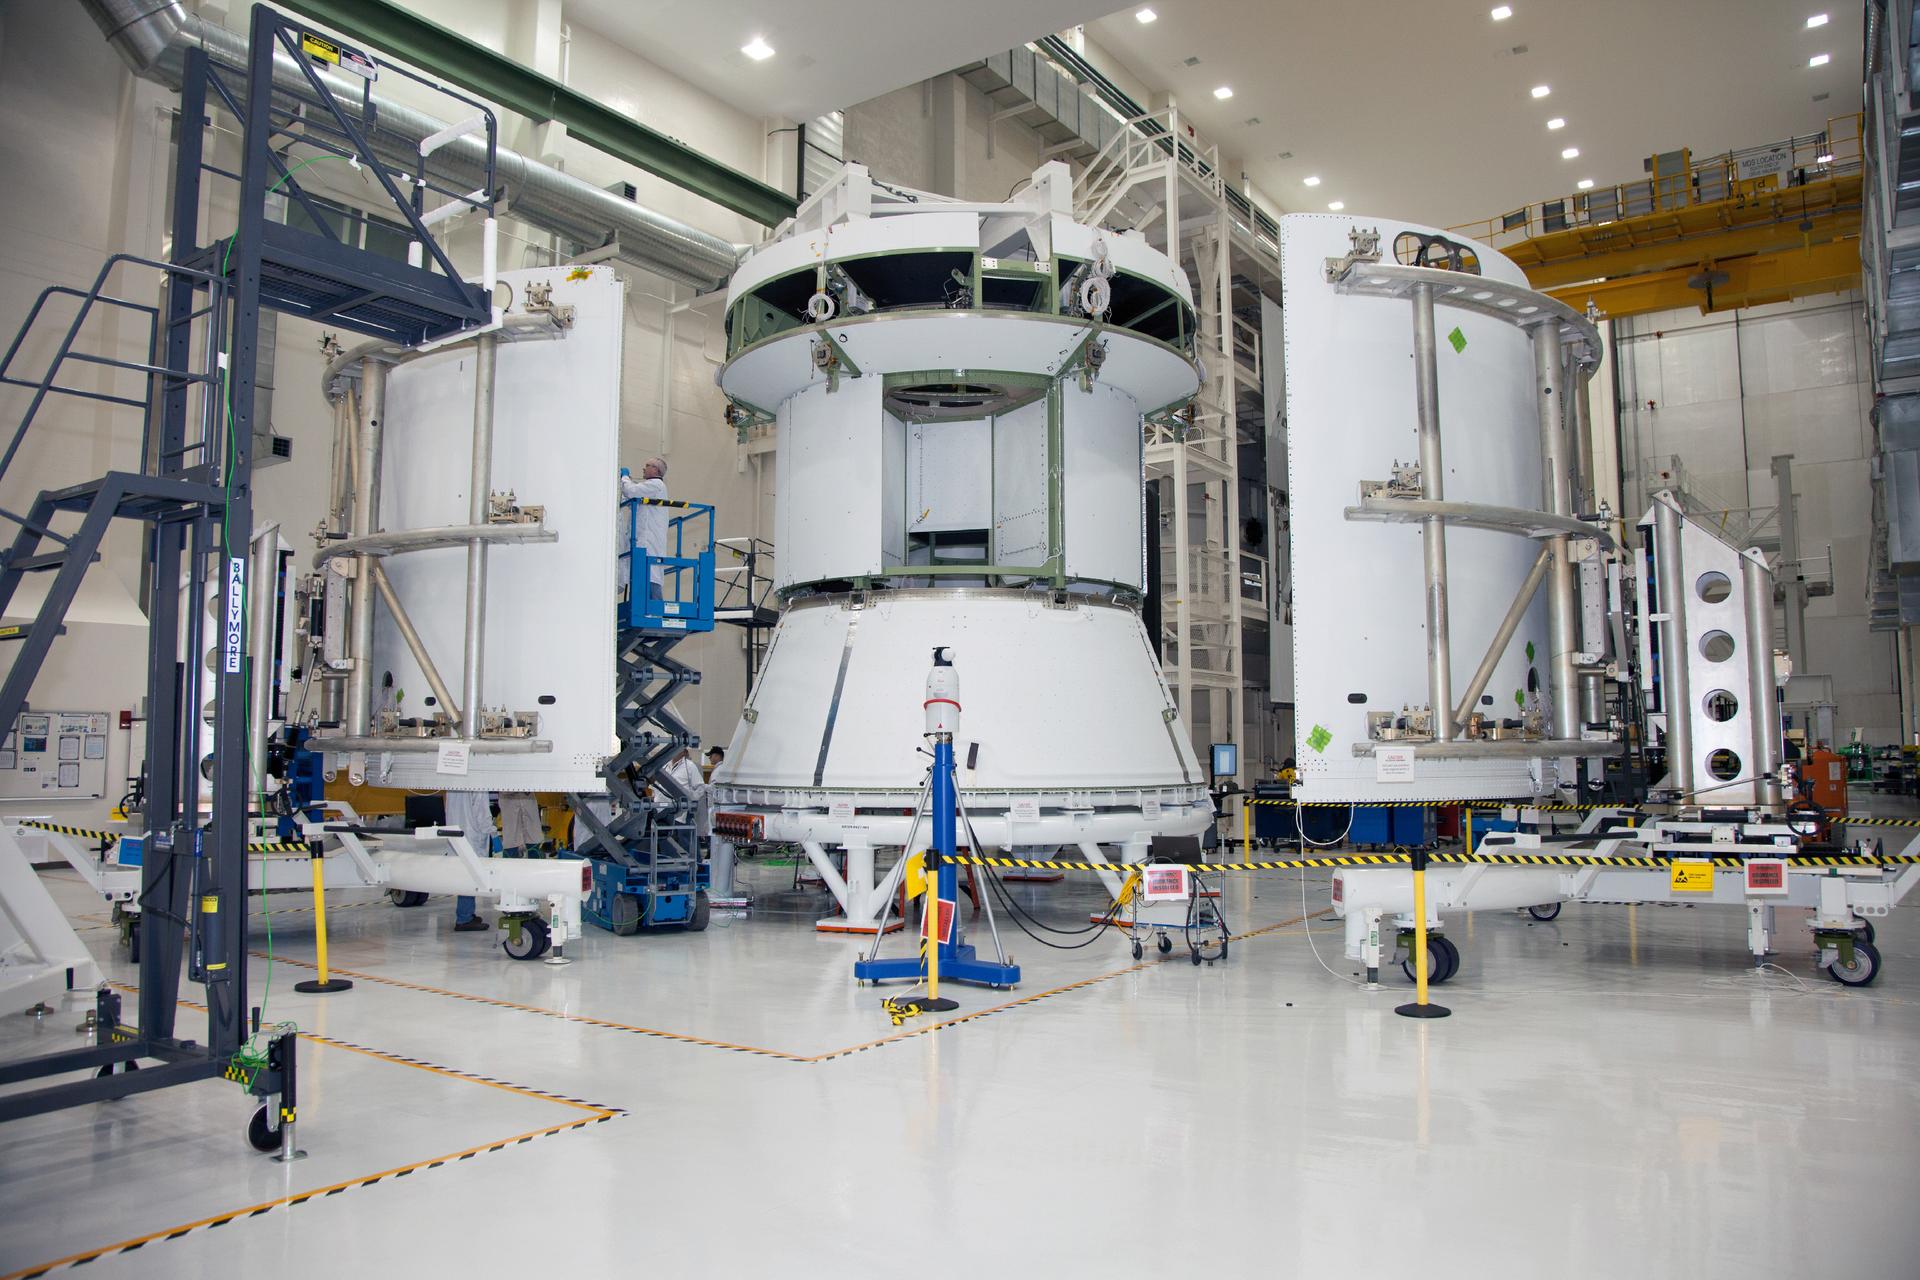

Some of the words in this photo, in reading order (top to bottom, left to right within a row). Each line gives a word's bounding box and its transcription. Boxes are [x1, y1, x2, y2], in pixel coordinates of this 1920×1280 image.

[309, 37, 334, 52] CAUTION
[1742, 159, 1756, 167] MDS
[1756, 152, 1787, 164] LOCATION
[228, 562, 241, 668] BALLYMORE
